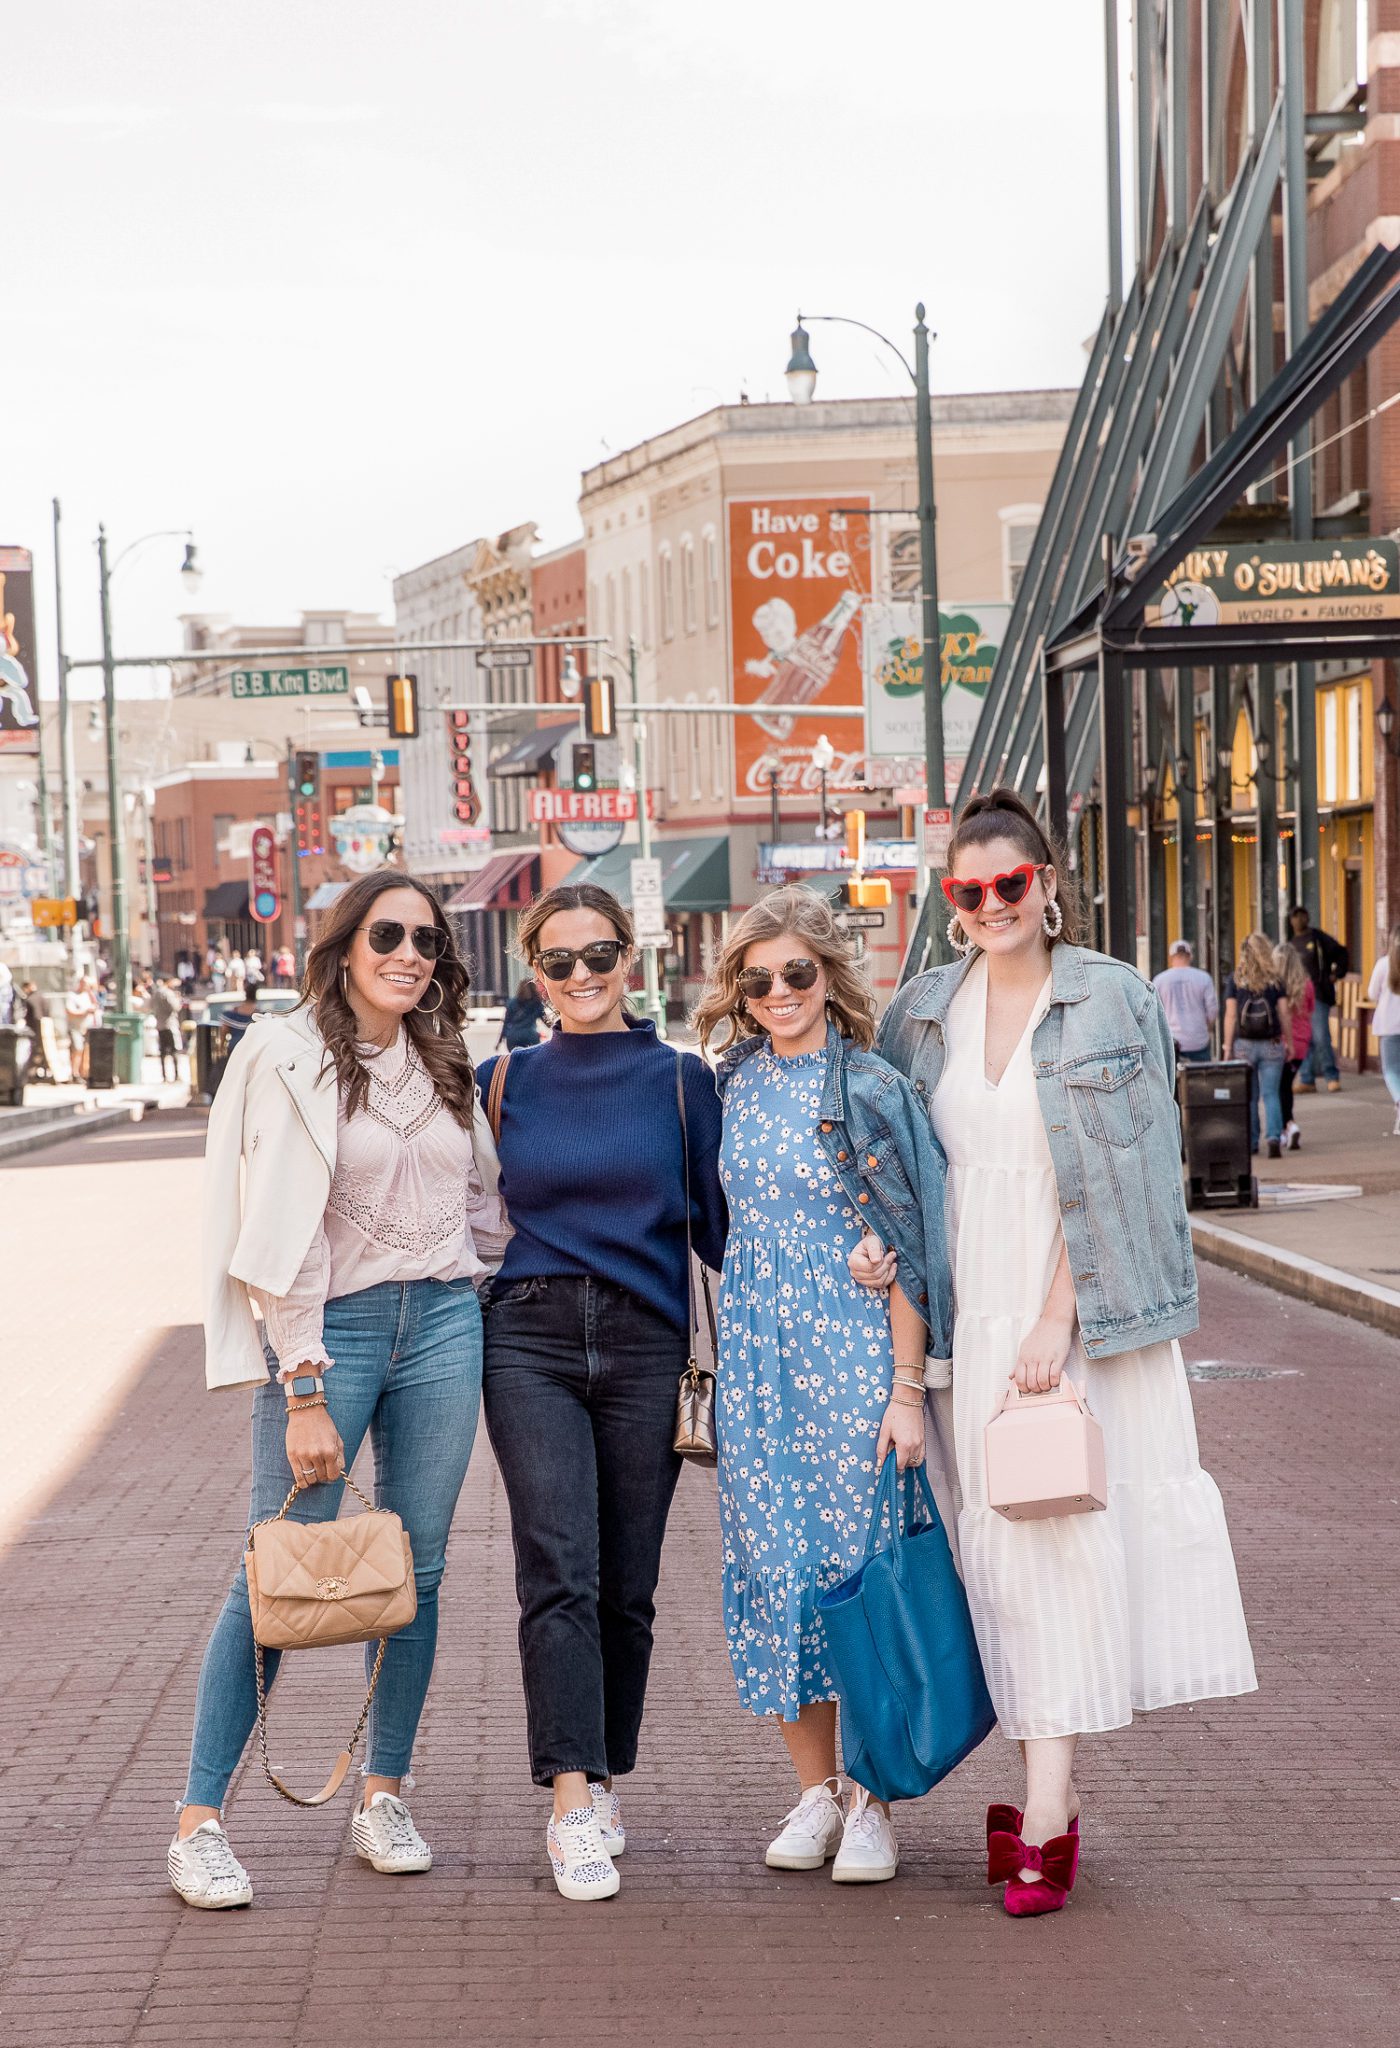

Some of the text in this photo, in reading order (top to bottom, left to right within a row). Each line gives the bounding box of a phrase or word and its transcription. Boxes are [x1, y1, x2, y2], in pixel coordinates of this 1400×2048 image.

[752, 507, 848, 534] Have a
[747, 538, 851, 579] Coke
[1163, 550, 1389, 596] ILKY O'SULLIVAN'S
[1237, 603, 1384, 623] WORLD FAMOUS
[234, 669, 348, 696] B.B. King Blvd.
